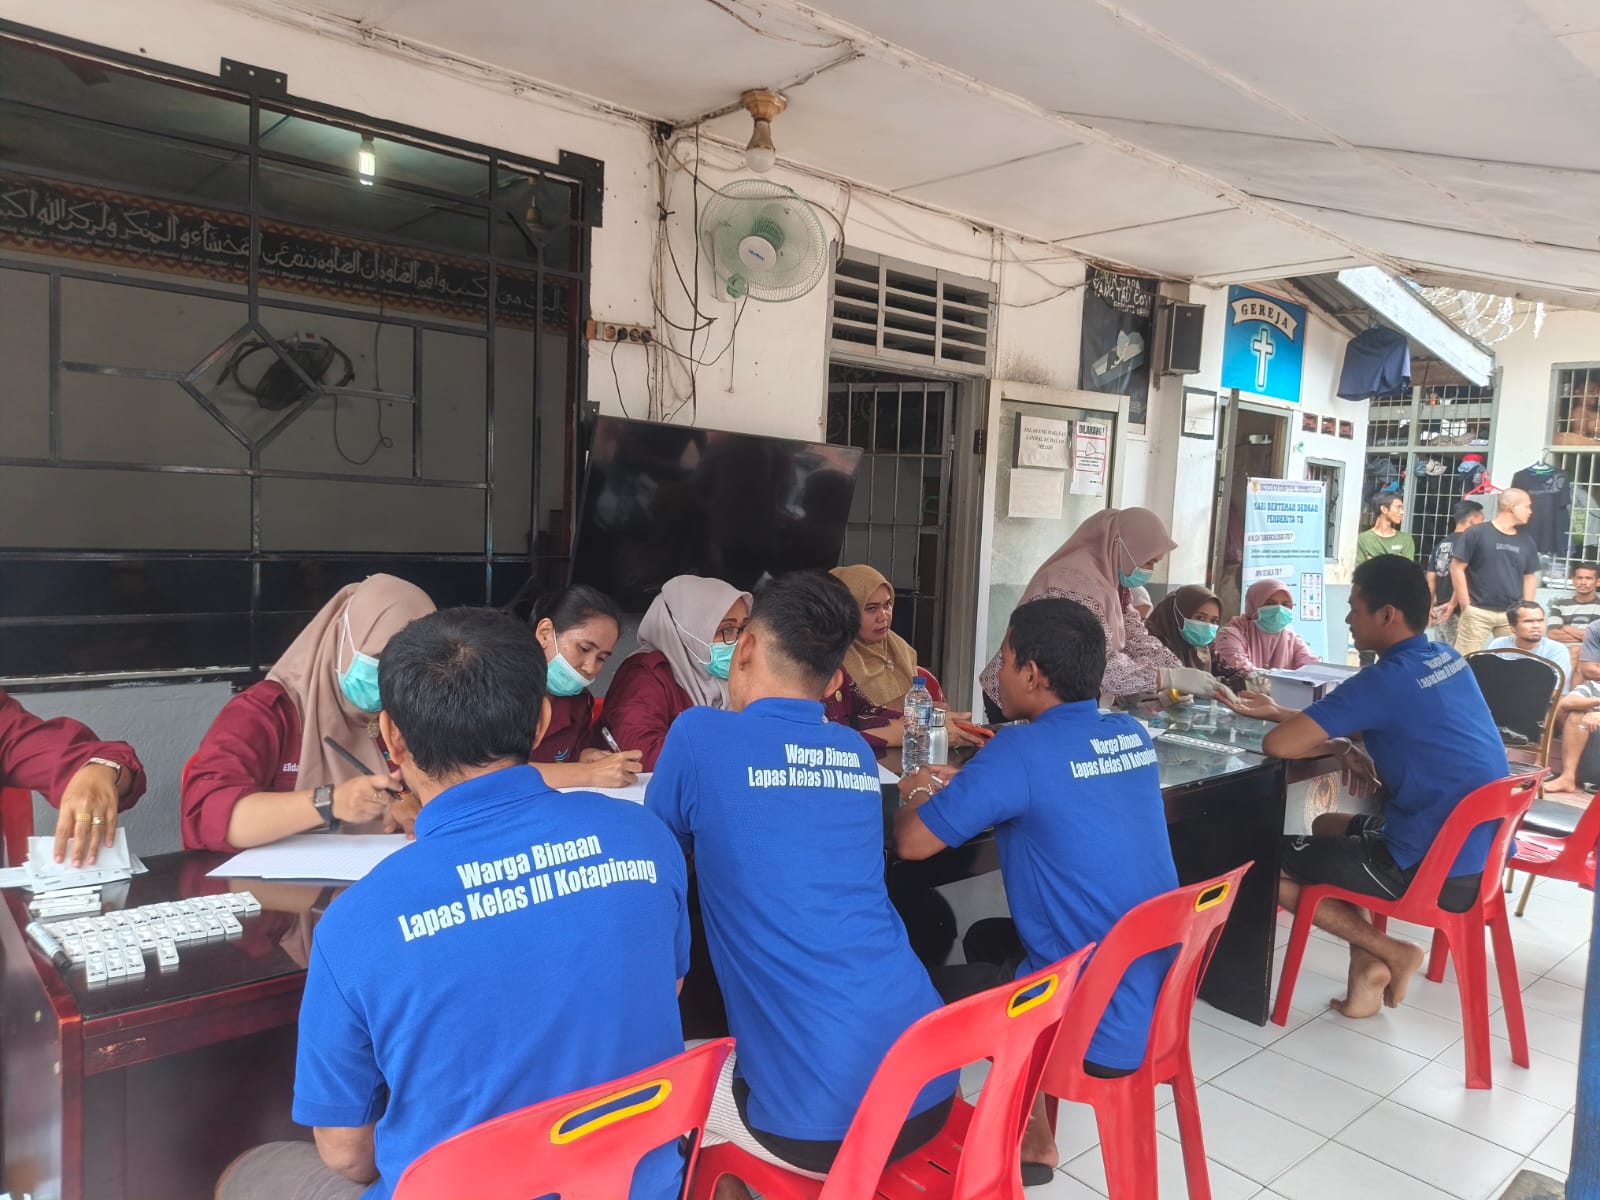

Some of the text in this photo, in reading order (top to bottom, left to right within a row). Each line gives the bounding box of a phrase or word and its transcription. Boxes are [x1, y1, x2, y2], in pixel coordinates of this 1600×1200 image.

[1241, 303, 1288, 329] GEREJA
[784, 743, 860, 768] Warga Binaan
[1089, 738, 1120, 755] Warga
[747, 766, 787, 788] Lapas
[788, 767, 821, 787] Kelas
[821, 769, 836, 788] III
[1070, 761, 1099, 778] Lapas
[1098, 756, 1123, 775] Kelas
[1119, 752, 1133, 771] III
[456, 835, 602, 889] Warga Binaan
[398, 858, 657, 942] Lapas Kelas III Kotapinang
